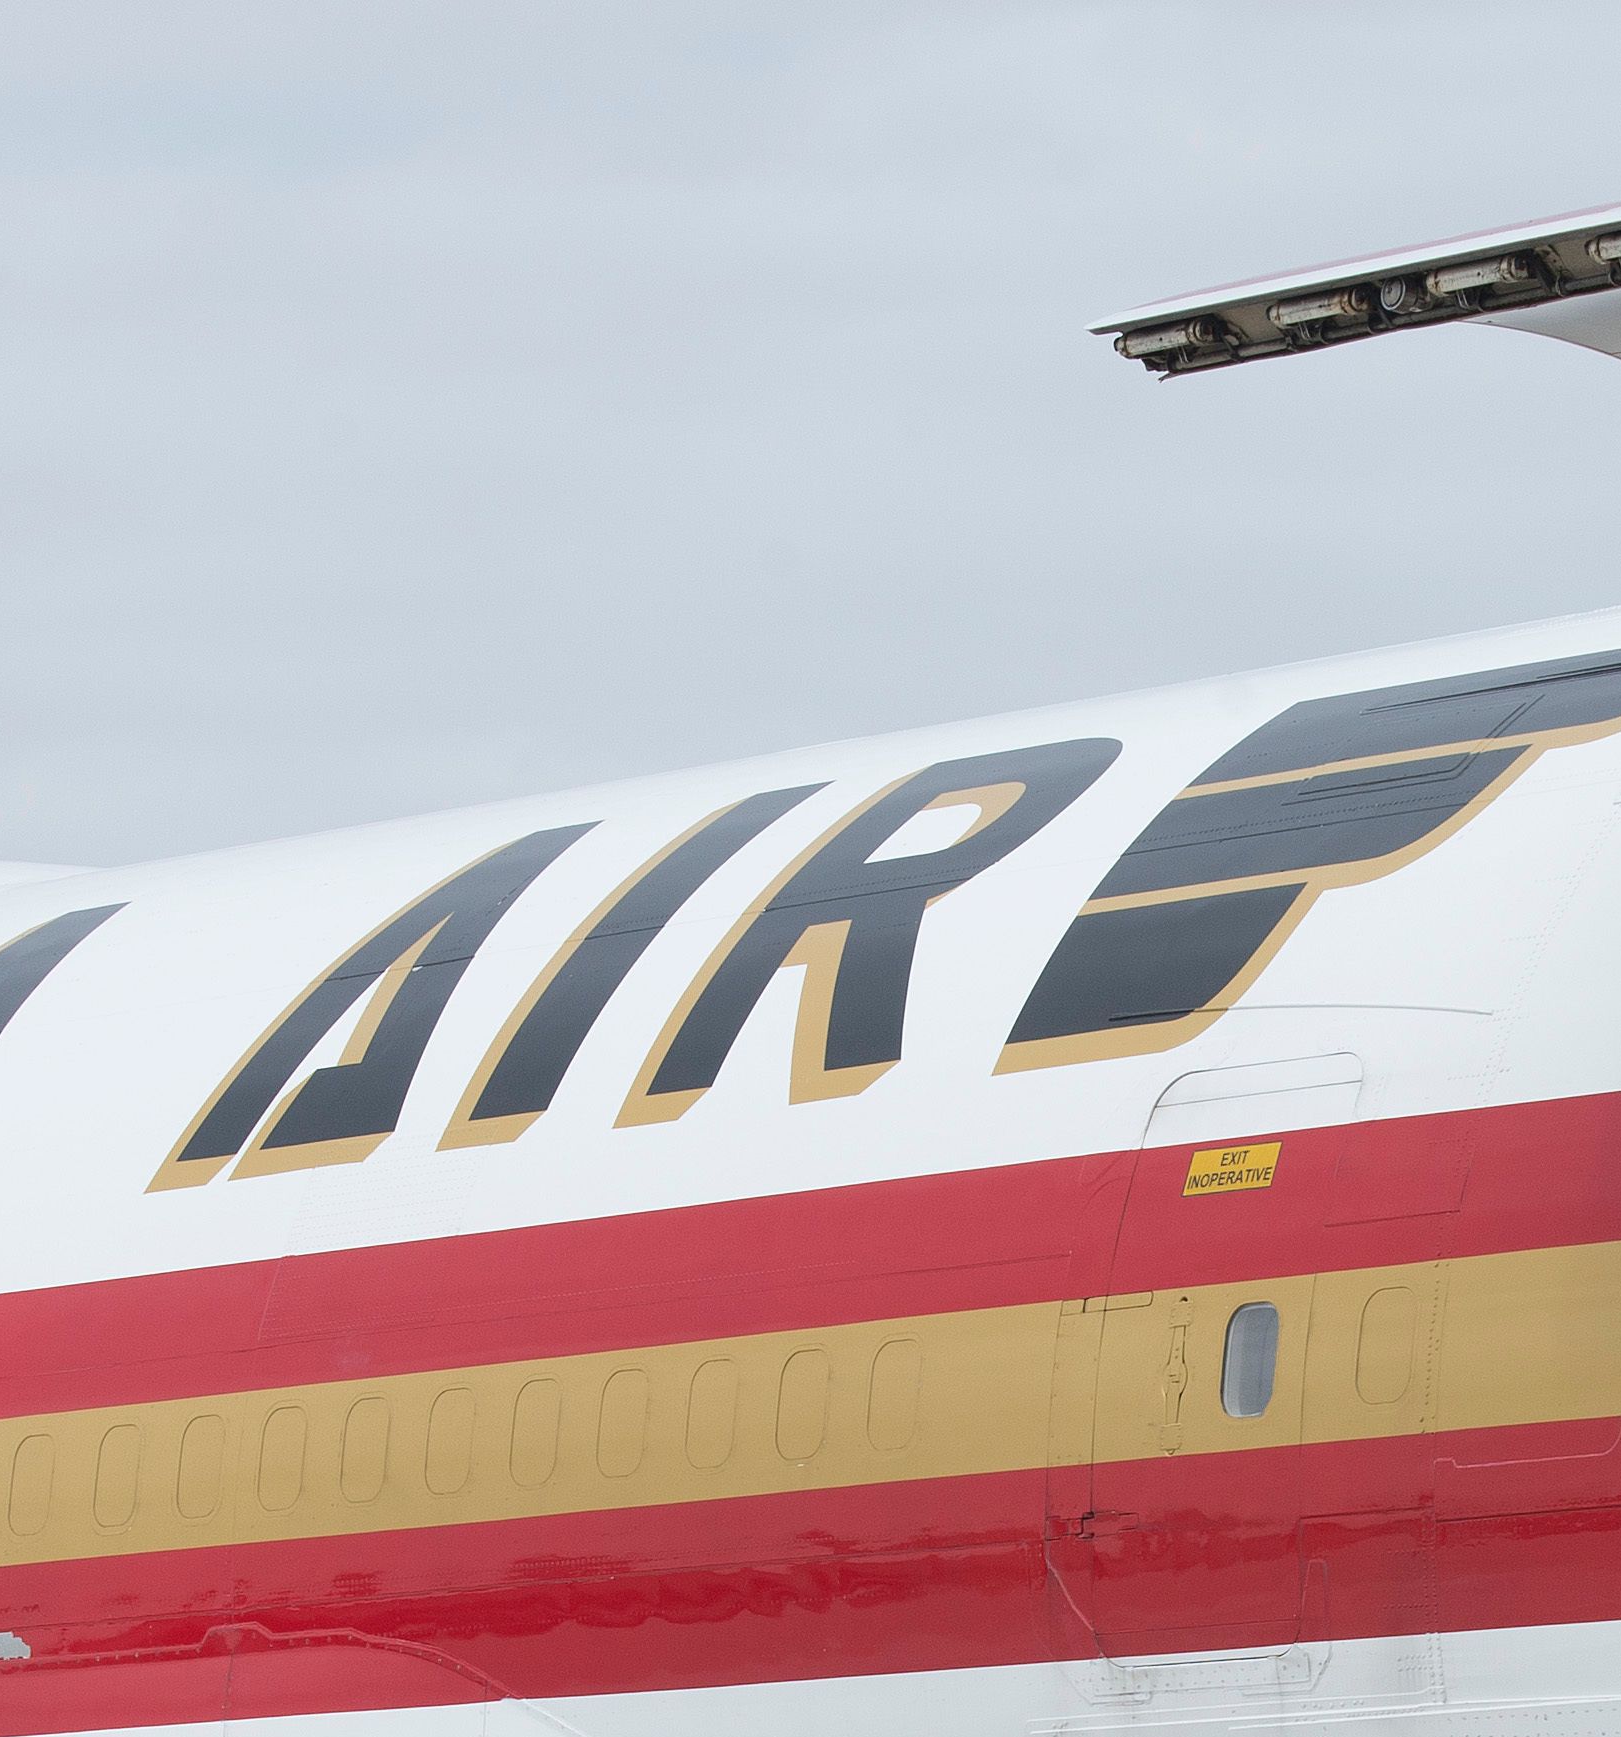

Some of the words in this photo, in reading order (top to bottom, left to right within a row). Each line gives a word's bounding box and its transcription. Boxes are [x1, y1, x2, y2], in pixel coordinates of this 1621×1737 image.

[145, 738, 1121, 1193] AIR
[1220, 1149, 1251, 1167] EXIT
[1186, 1166, 1273, 1190] INOPERATIVE
